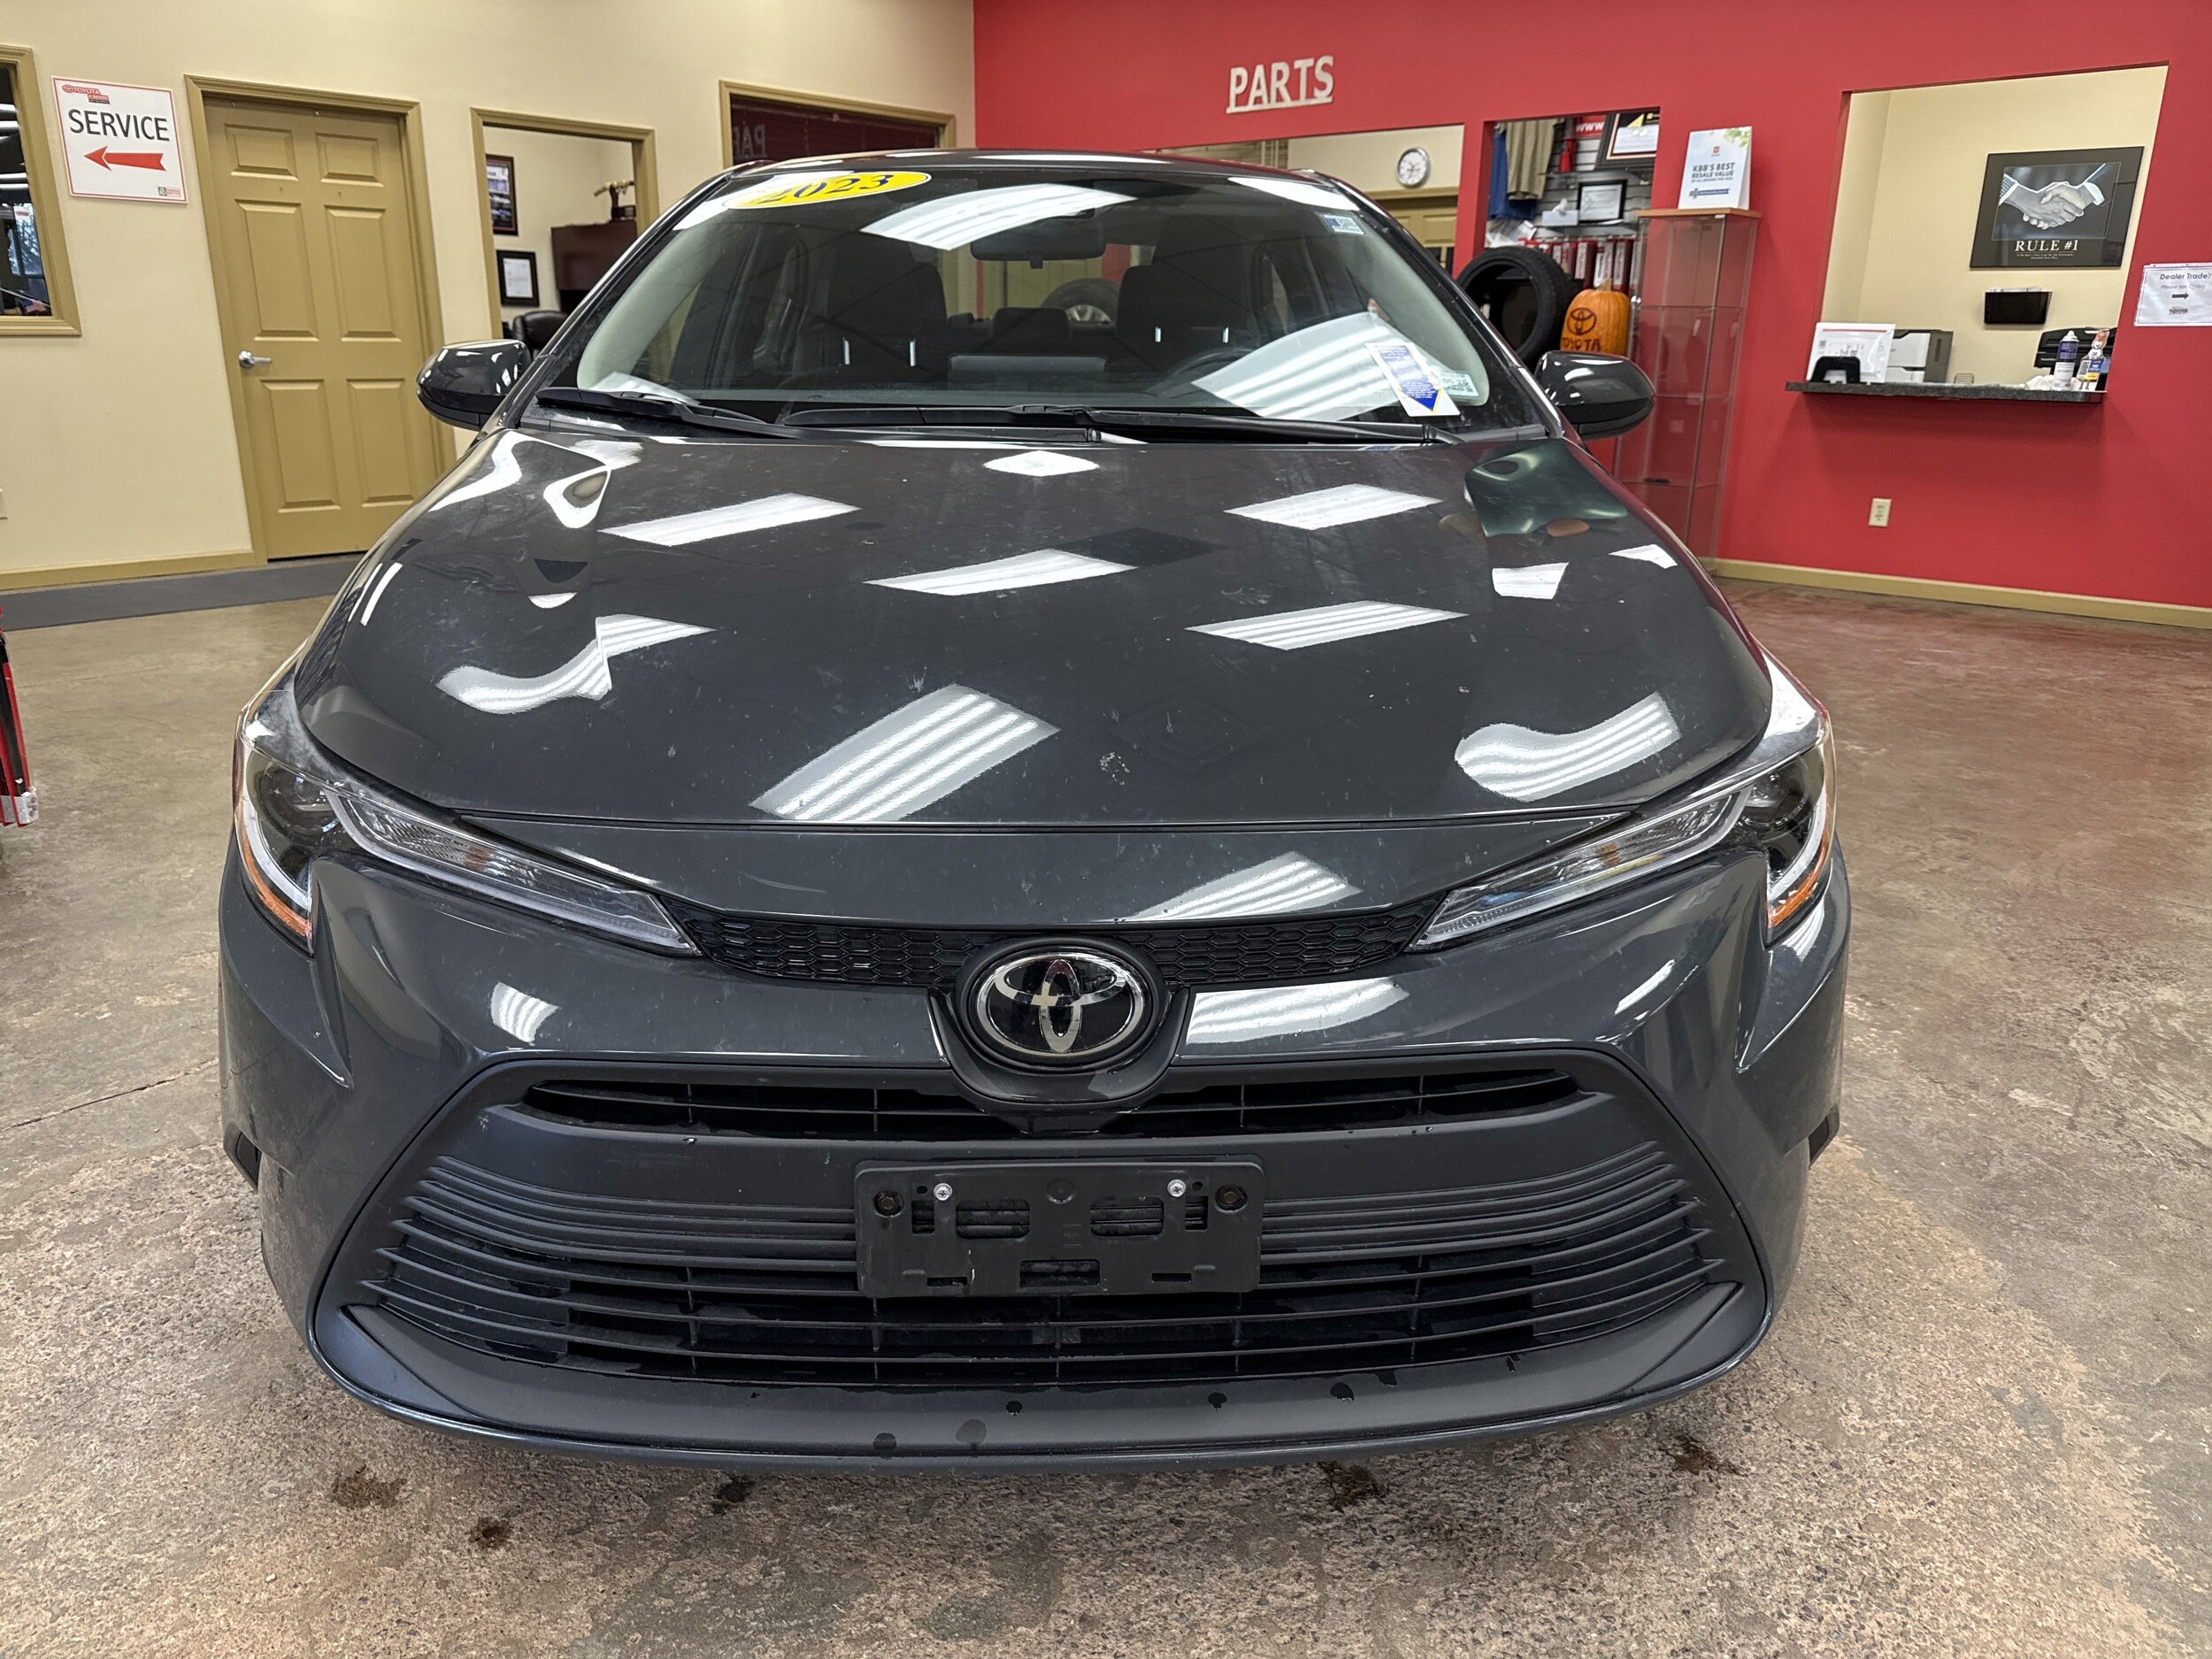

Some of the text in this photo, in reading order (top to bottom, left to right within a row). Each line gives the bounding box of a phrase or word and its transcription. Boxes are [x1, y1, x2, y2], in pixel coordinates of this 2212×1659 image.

[1228, 55, 1333, 107] PARTS
[68, 109, 170, 142] SERVICE
[1716, 162, 1735, 171] BEST
[757, 174, 894, 204] 2023
[2015, 239, 2078, 251] RULE #1
